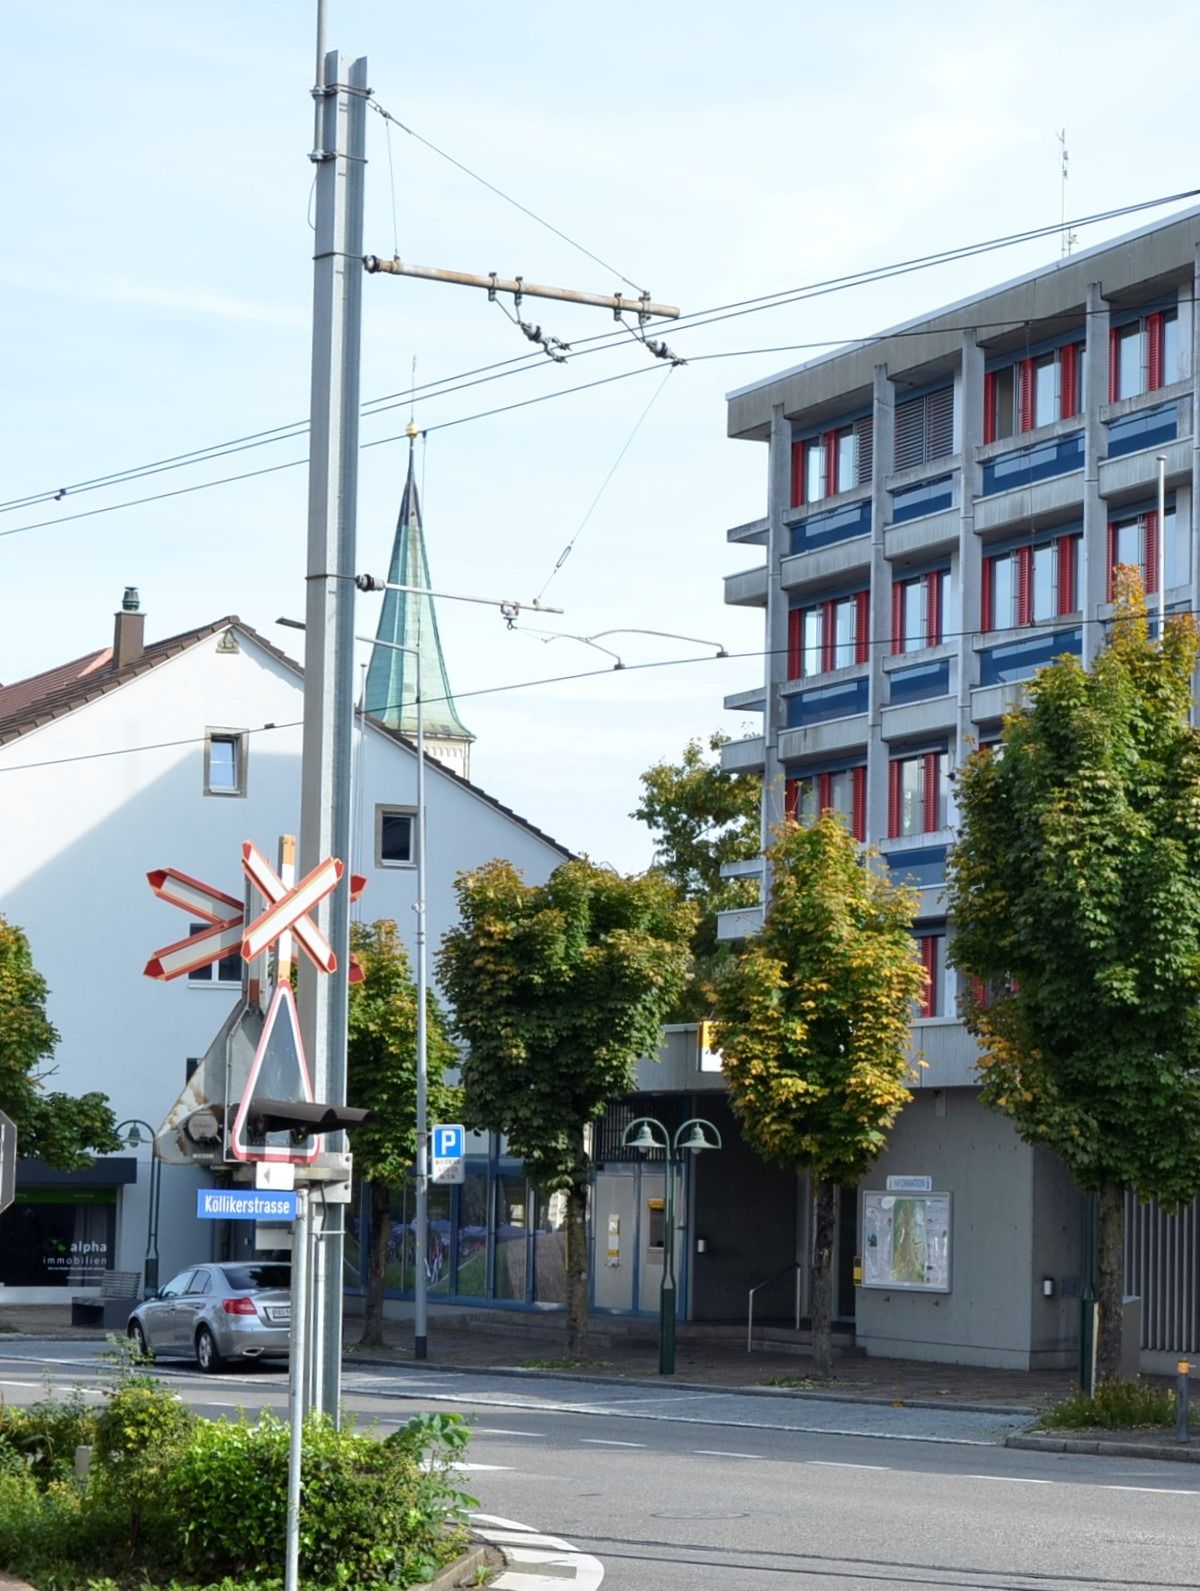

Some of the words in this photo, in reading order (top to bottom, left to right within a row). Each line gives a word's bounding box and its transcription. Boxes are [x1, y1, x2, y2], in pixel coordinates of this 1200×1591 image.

[441, 1130, 456, 1156] P
[204, 1194, 290, 1214] Köllikerstrasse
[70, 1241, 108, 1254] alpha
[42, 1256, 107, 1265] immobilien
